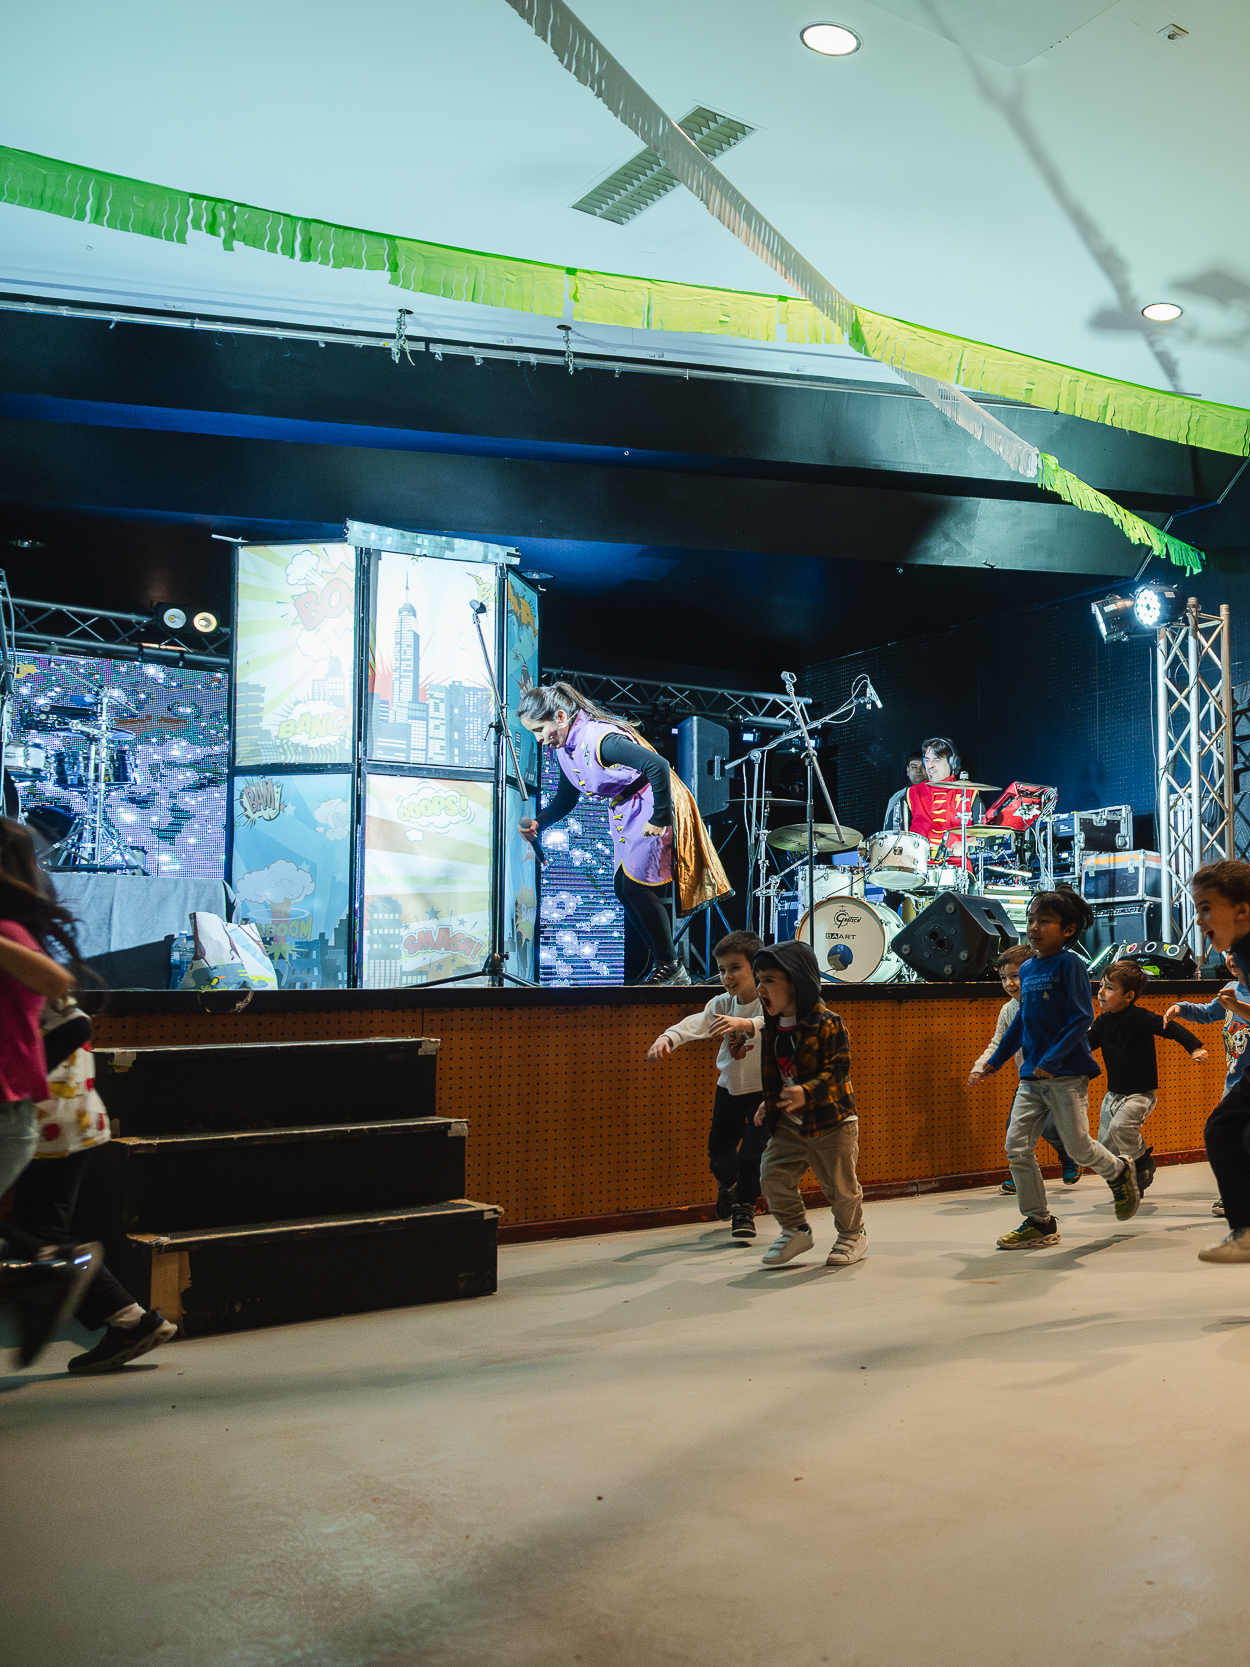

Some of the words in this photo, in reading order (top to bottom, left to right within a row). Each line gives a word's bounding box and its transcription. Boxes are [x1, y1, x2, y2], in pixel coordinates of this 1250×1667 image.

[293, 578, 355, 632] BO
[278, 702, 353, 740] BANG!
[243, 778, 276, 814] BAM
[397, 795, 468, 821] OOOPS!
[256, 917, 313, 942] ABOOM
[403, 927, 484, 960] SMASH!
